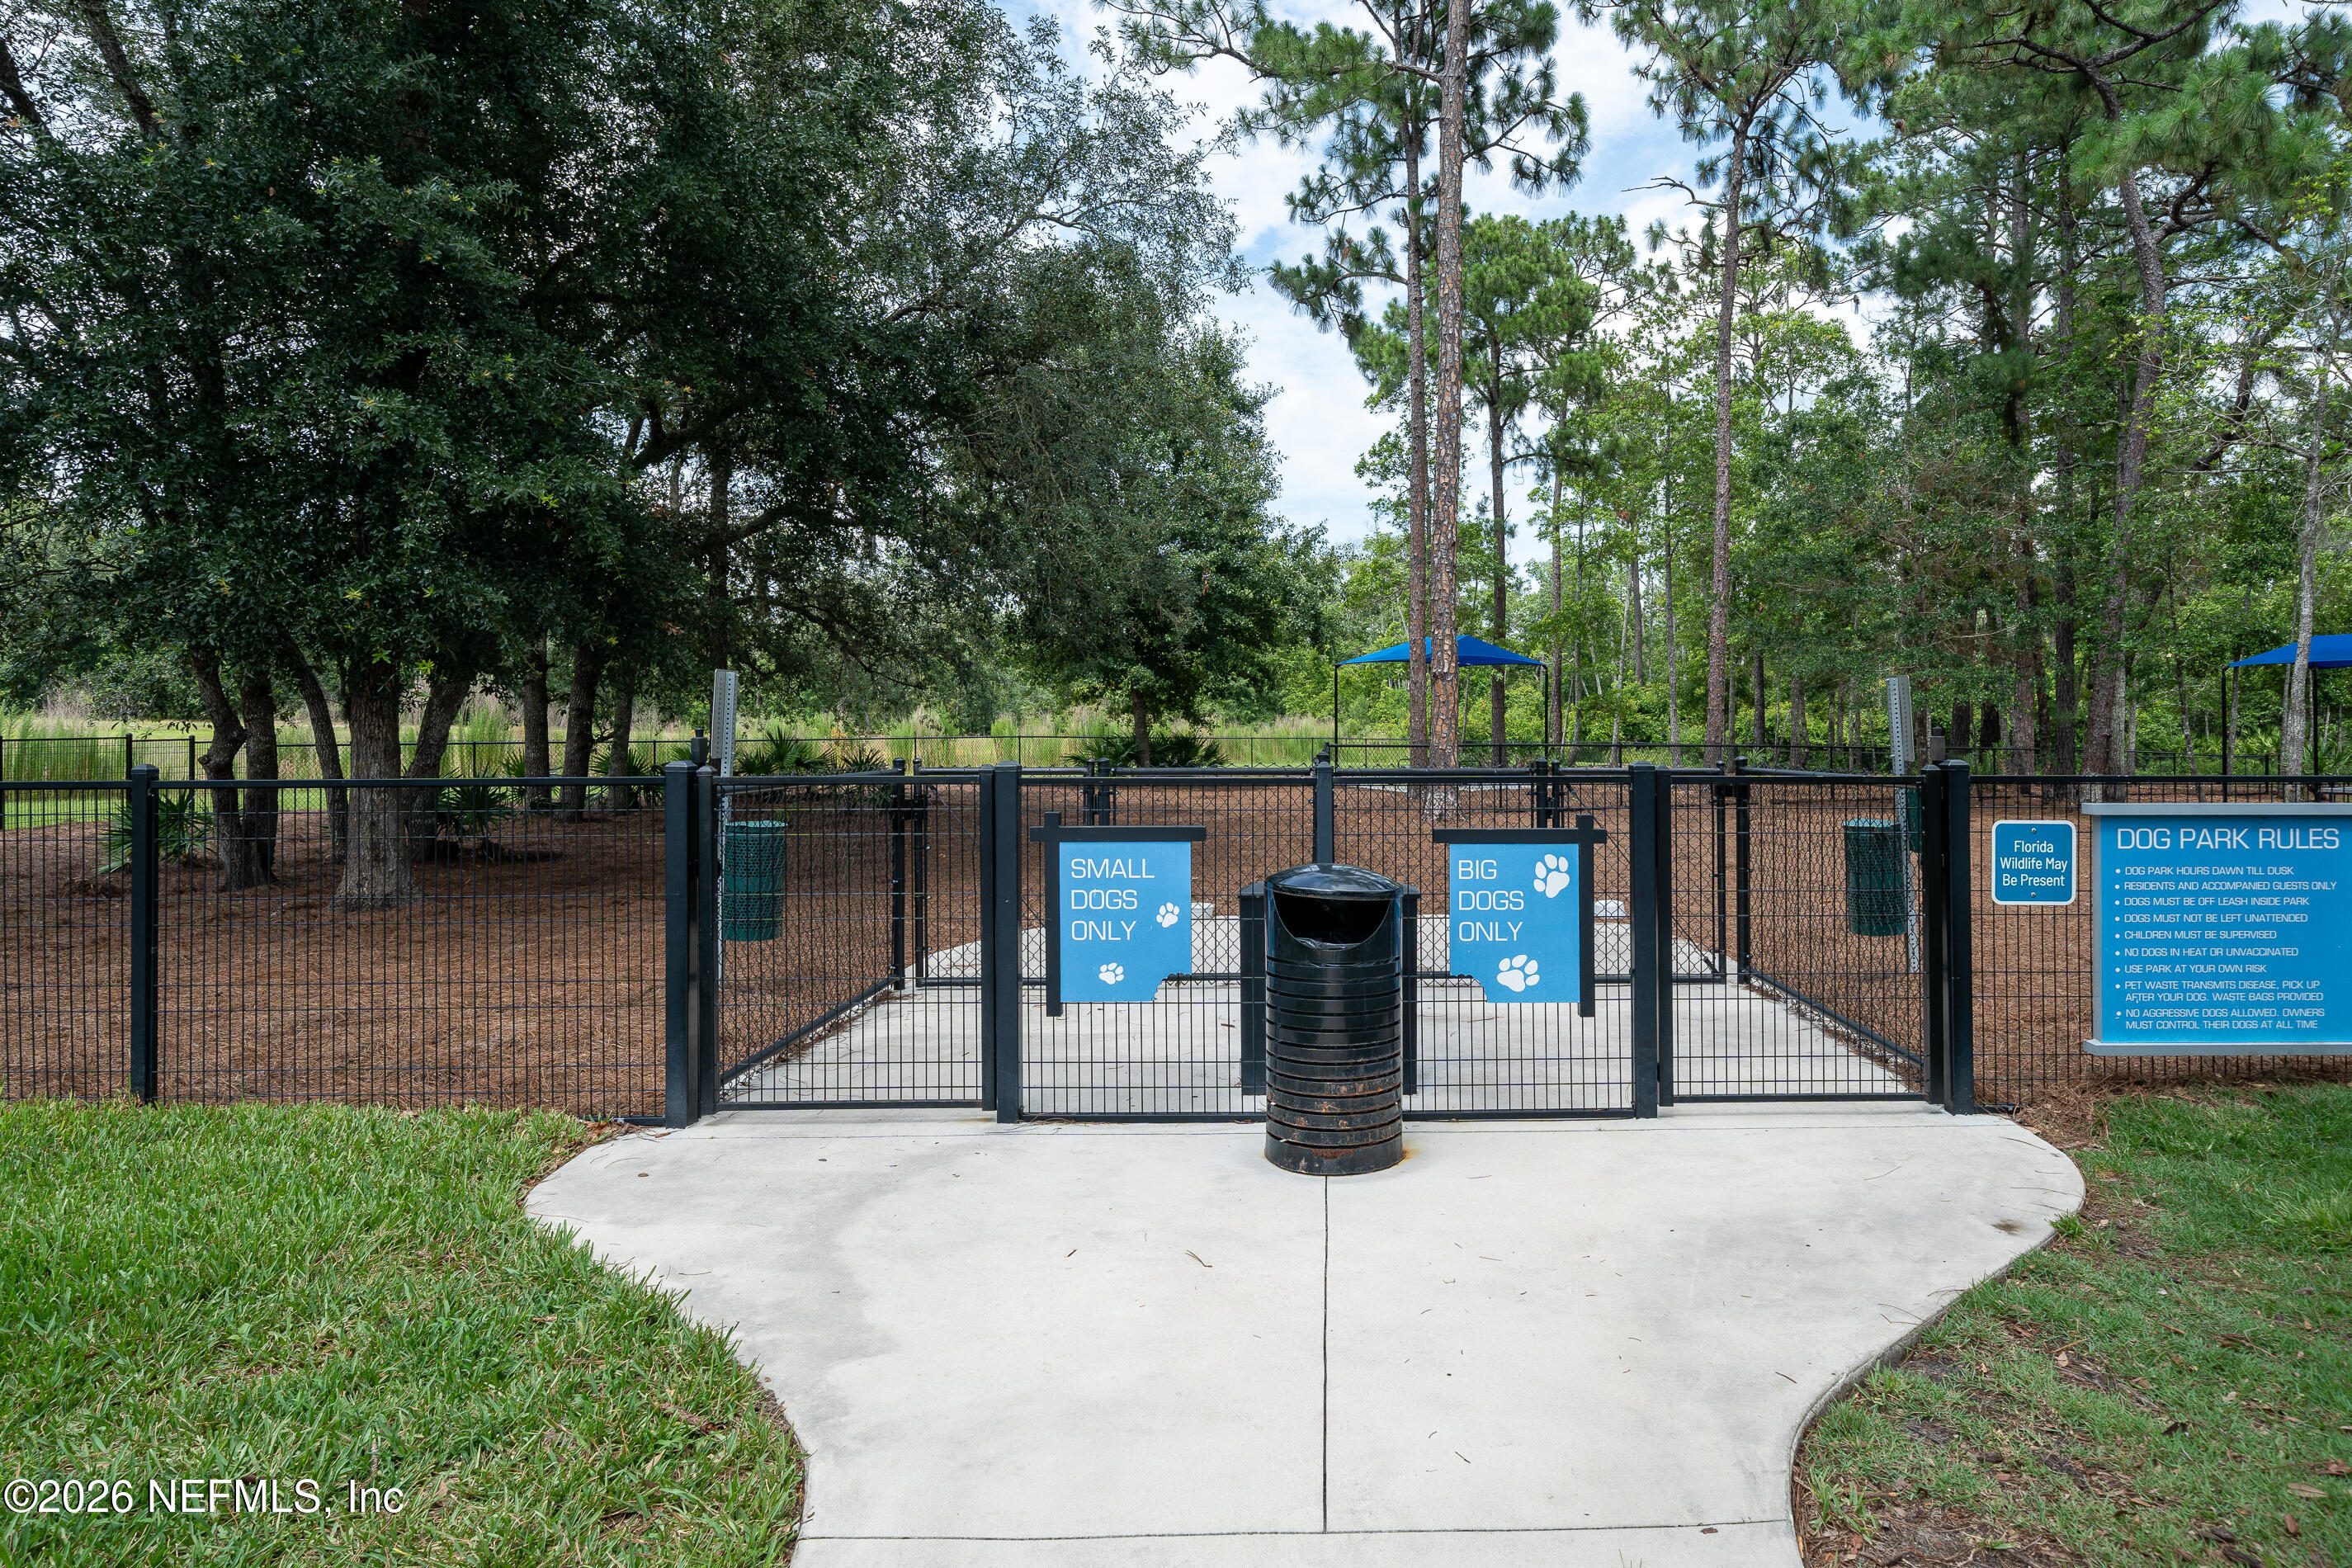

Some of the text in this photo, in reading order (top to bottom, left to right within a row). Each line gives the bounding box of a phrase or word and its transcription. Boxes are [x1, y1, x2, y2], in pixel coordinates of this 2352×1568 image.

[2118, 828, 2340, 849] DOG PARK RULES
[2014, 840, 2053, 852] Florida
[1071, 858, 1155, 878] SMALL
[2000, 857, 2067, 872] Wildlife May
[1458, 860, 1497, 880] BIG
[2125, 867, 2294, 876] DOG PARK HOURS DAWN TILL DUSK
[2003, 874, 2065, 886] Be Present
[2124, 881, 2336, 890] RESIDENTS AND ACCOMPANIED GUESTS ONLY
[1071, 890, 1137, 909] DOGS
[1459, 890, 1524, 910] DOGS
[2124, 897, 2309, 906] DOGS MUST BE OFF LEASH INSIDE PARK
[2124, 914, 2308, 923] DOGS MUST NOT BE LEFT UNATTENDED
[1071, 920, 1136, 941] ONLY
[1459, 921, 1523, 942] ONLY
[2124, 930, 2277, 939] CHILDREN MUST BE SUPERVISED
[2124, 947, 2298, 956] NO DOGS IN HEAT OR UNVACCINATED
[2124, 964, 2267, 973] USE PARK AT YOUR OWN RISK
[2125, 980, 2320, 990] PET WASTE TRANSMITS DISEASE, PICK UP
[2125, 992, 2324, 1001] AFTER YOUR DOG. WASTE BAGS PROVIDED
[2126, 1008, 2325, 1018] NO AGGRESSIVE DOGS ALLOWED. OWNERS
[2126, 1020, 2317, 1029] MUST CONTROL THEIR DOGS AT ALL TIME
